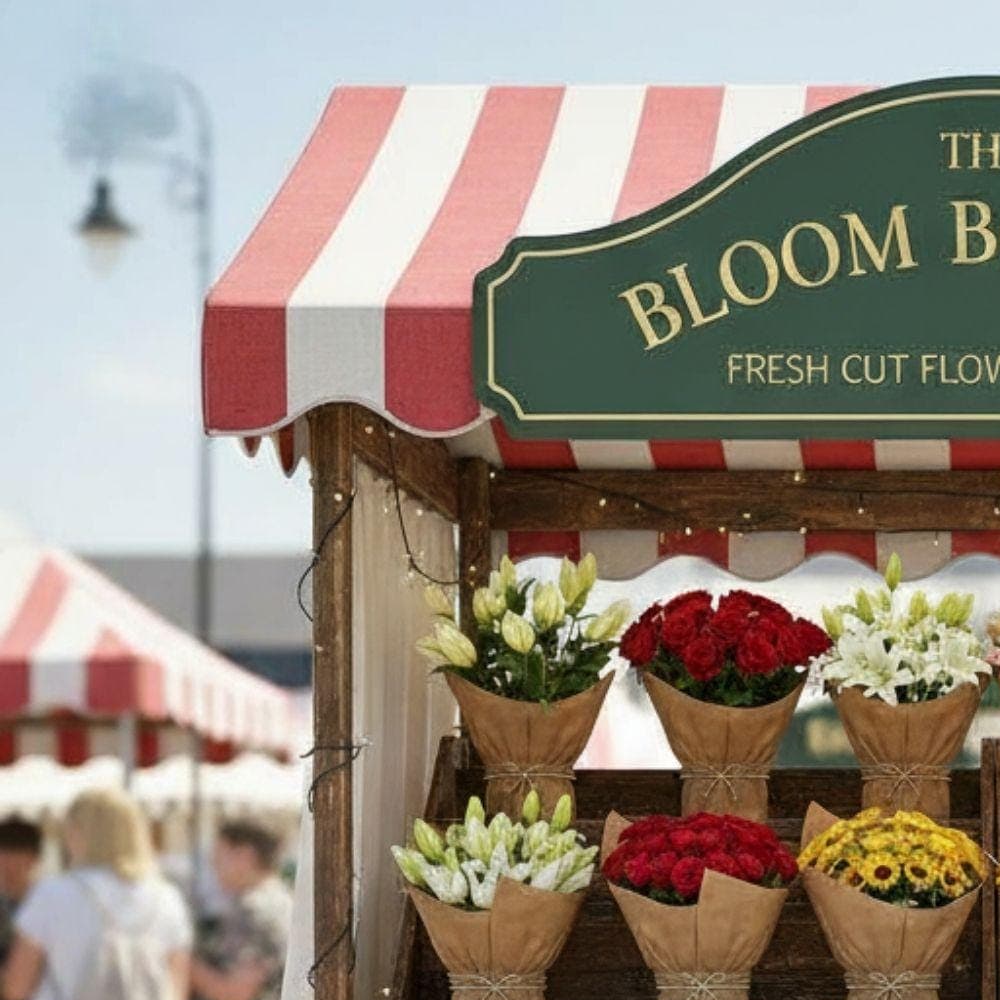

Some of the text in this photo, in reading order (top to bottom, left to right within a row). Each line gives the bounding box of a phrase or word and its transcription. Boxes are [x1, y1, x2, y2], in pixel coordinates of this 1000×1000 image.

[617, 204, 918, 351] BLOOM
[727, 353, 829, 384] FRESH
[841, 353, 910, 384] CUT
